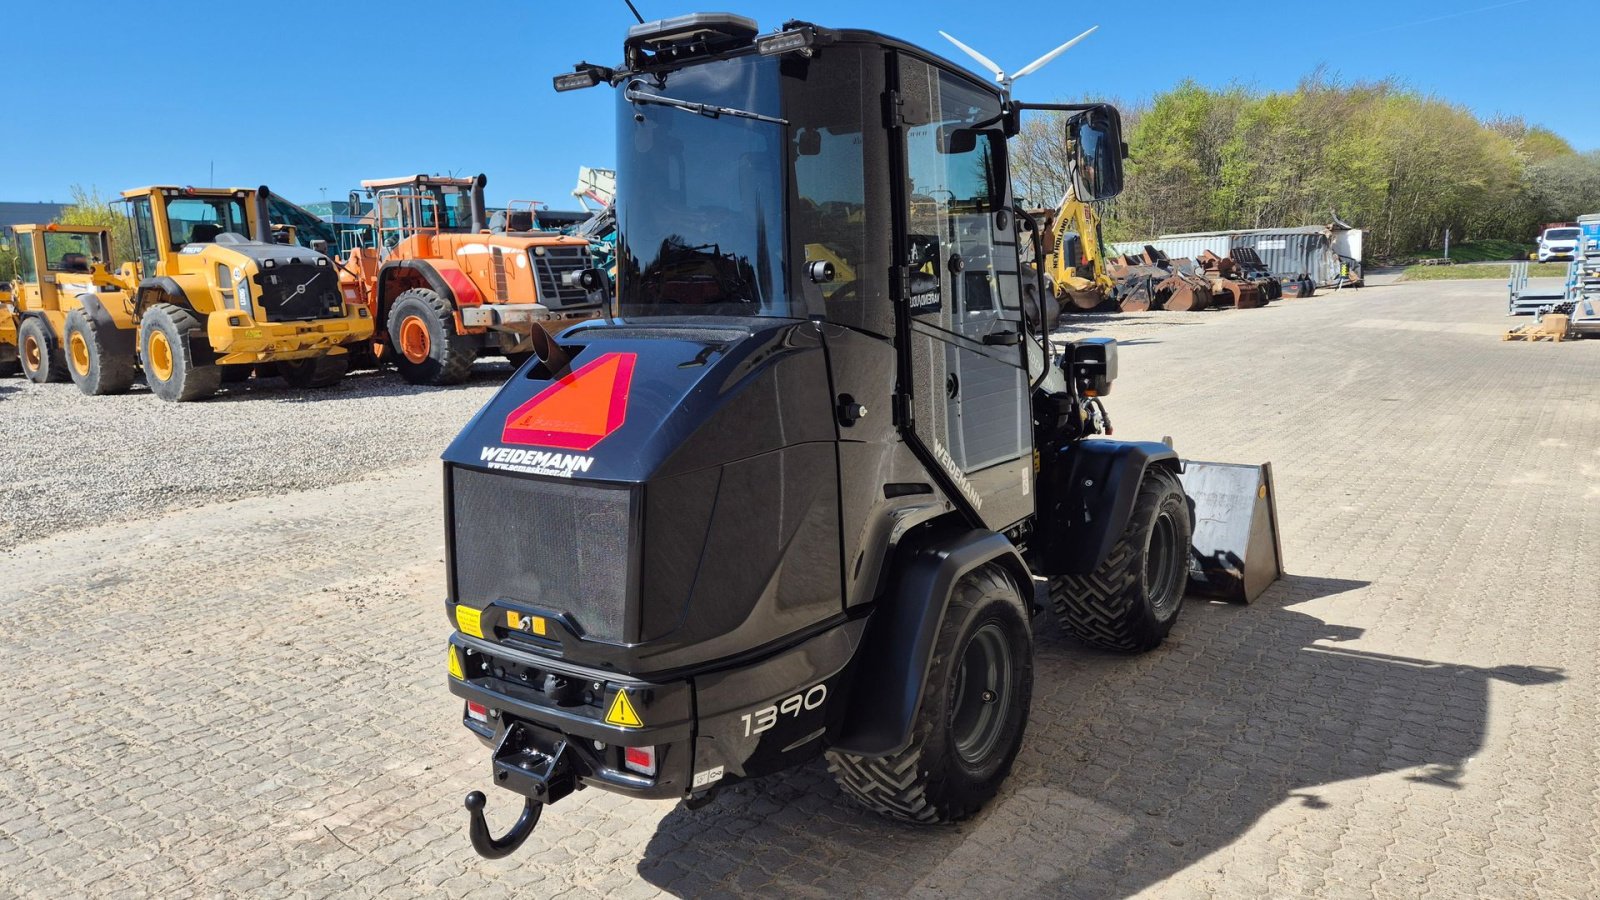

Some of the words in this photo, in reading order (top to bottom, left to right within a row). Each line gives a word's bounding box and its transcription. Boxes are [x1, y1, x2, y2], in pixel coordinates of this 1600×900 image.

[1054, 218, 1069, 251] HOLLAND
[480, 446, 594, 473] WEIDEMANN
[934, 438, 983, 511] WEIDEMANN
[741, 683, 827, 738] 1390
